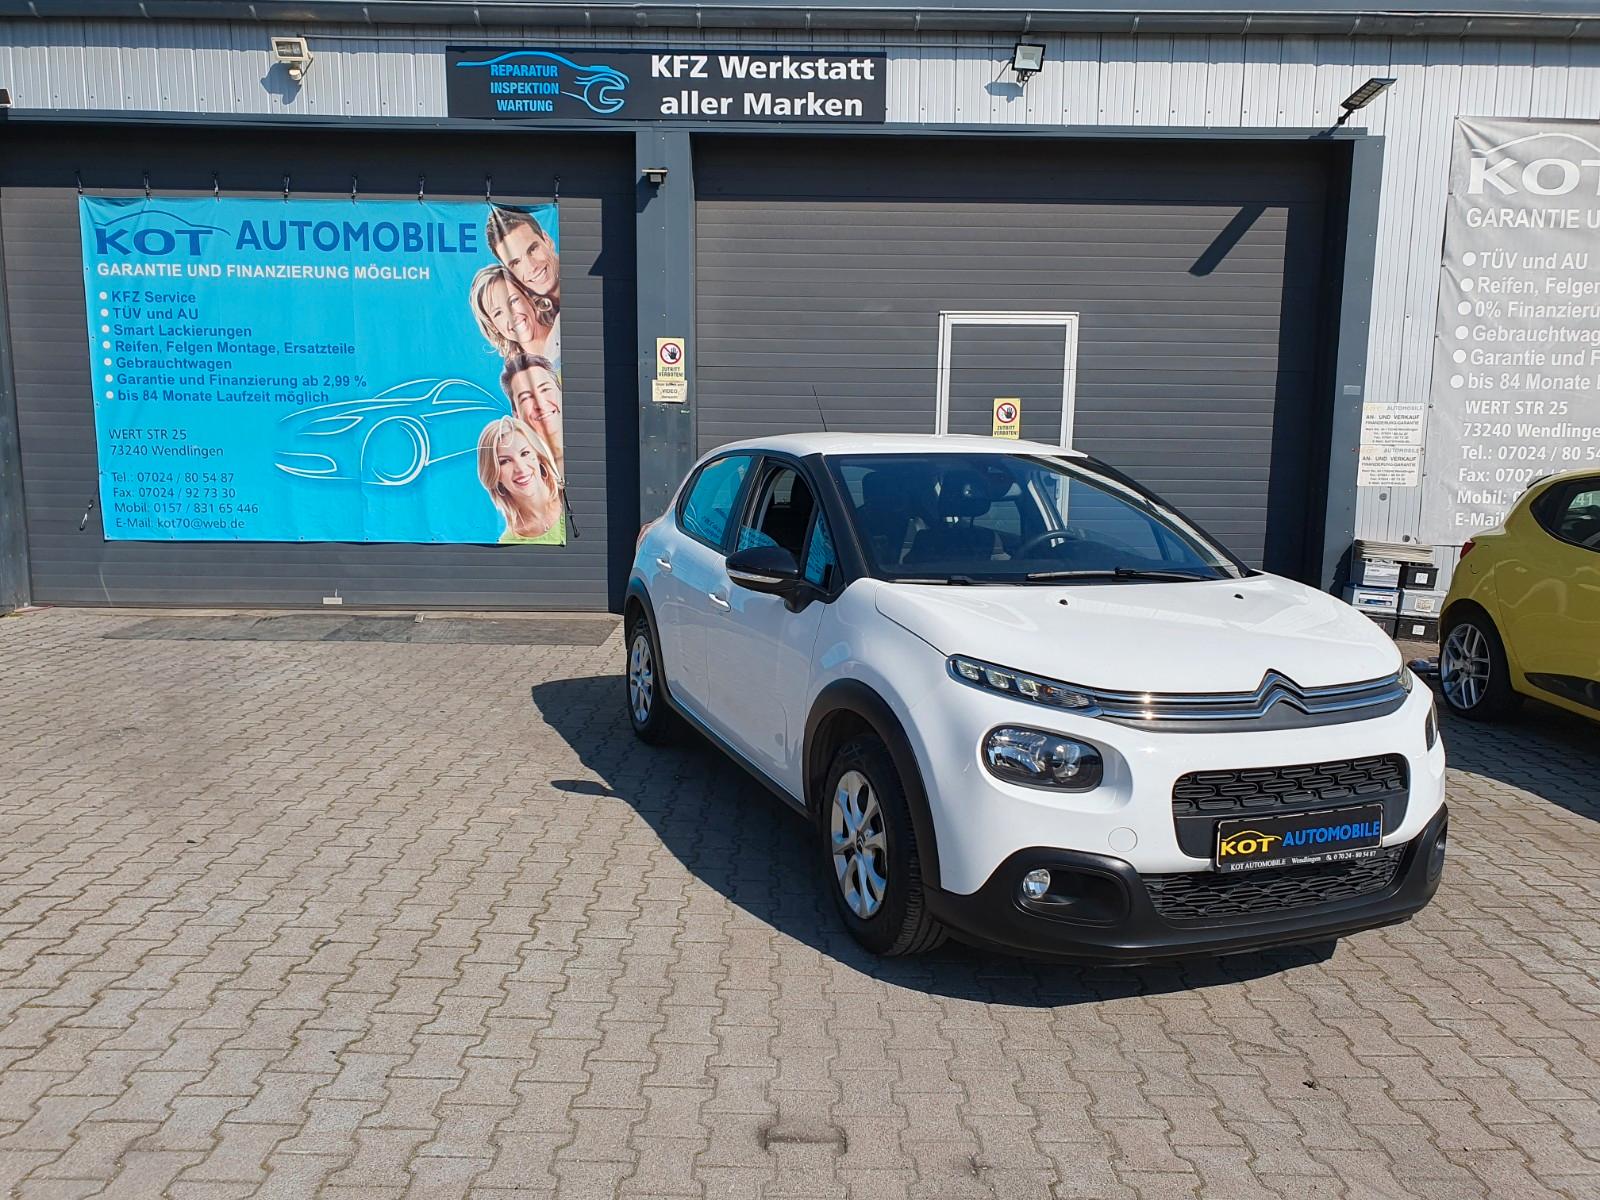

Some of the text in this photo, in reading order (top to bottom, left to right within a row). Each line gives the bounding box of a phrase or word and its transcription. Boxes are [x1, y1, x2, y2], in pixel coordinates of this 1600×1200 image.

[490, 64, 558, 77] REPARATUR
[651, 54, 875, 81] KFZ Werkstatt
[490, 81, 560, 95] INSPEKTION
[496, 99, 553, 112] WARTUNG
[660, 90, 863, 117] aller Marken
[1466, 207, 1580, 229] GARANTIE
[95, 219, 478, 256] KOT AUTOMOBILE
[1480, 248, 1589, 270] TÜV und AU
[97, 262, 430, 280] GARANTIE UND FINANZIERUNG MÖGLICH
[1477, 276, 1539, 296] Reifen,
[111, 290, 196, 304] KFZ Service
[112, 305, 199, 320] TÜV und AU
[1475, 300, 1501, 318] 0%
[114, 323, 252, 339] Smart Lackierungen
[1472, 325, 1600, 346] Gebrauchtwag
[115, 340, 356, 356] Reifen, Felgen Montage, Ersatzteile
[116, 357, 232, 372] Gebrauchtwagen
[1470, 348, 1545, 366] Garantie
[1551, 350, 1585, 366] und
[117, 373, 367, 389] Garantie und Finanzierung ab 2,99 %
[1468, 372, 1494, 389] bis
[1500, 373, 1521, 390] 84
[1525, 373, 1591, 390] Monate
[118, 389, 329, 405] bis 84 Monate Laufzeit möglich
[1465, 400, 1568, 415] WERT STR 25
[108, 428, 187, 440] WERT STR 25
[1463, 422, 1512, 437] 73240
[110, 444, 224, 458] 73240 Wendlingen
[1461, 445, 1492, 460] Tel.:
[1497, 446, 1546, 460] 07024
[1561, 446, 1581, 460] 80
[137, 472, 173, 483] 07024
[184, 472, 199, 483] 80
[203, 472, 217, 483] 54
[220, 472, 234, 483] 87
[1459, 467, 1490, 482] Fax:
[113, 487, 134, 498] Fax:
[138, 487, 174, 498] 07024
[185, 488, 199, 499] 92
[204, 488, 218, 499] 73
[222, 488, 236, 499] 30
[1456, 490, 1507, 505] Mobil:
[114, 502, 150, 513] Mobil:
[153, 503, 182, 513] 0157
[193, 503, 214, 514] 831
[218, 503, 233, 514] 65
[236, 503, 259, 514] 446
[116, 517, 245, 530] E-Mail: kot70@web.de
[1220, 820, 1380, 856] KOT AUTOMOBILE
[1230, 863, 1244, 871] KOT
[1244, 858, 1286, 870] AUTOMOBILE
